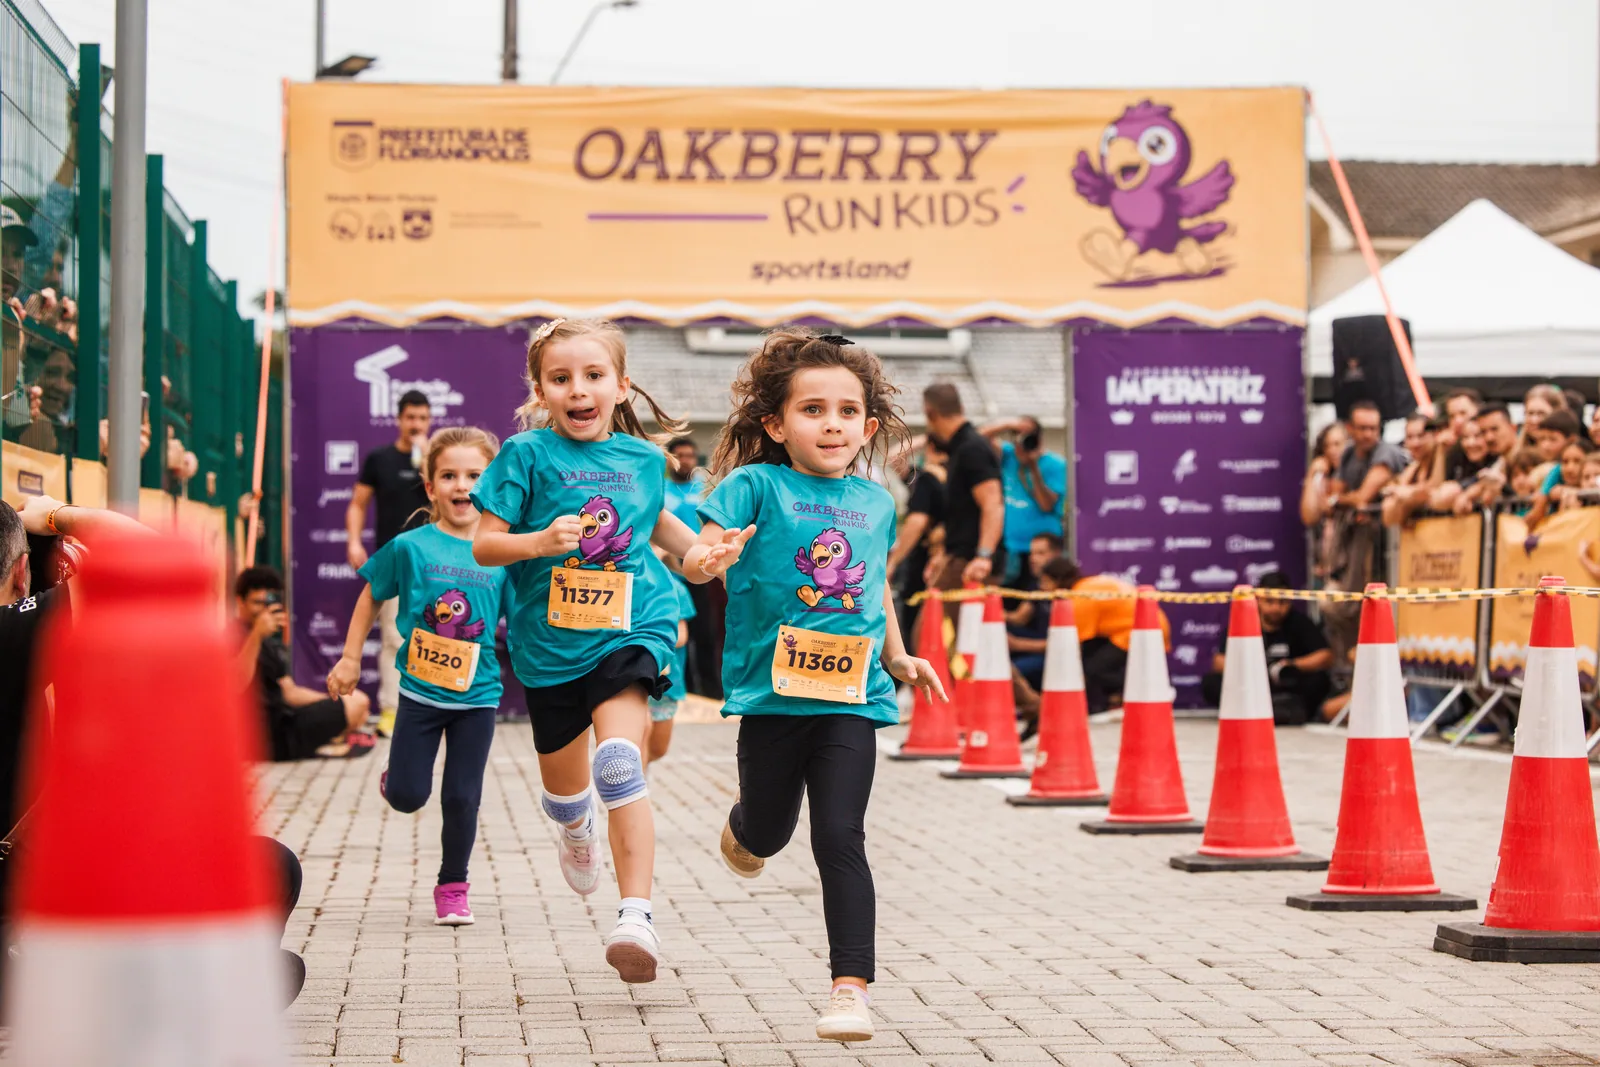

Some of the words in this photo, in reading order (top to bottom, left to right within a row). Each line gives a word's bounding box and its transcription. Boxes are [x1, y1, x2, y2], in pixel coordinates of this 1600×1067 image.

[379, 128, 498, 142] PREFEITURA
[504, 128, 529, 142] DE
[573, 127, 998, 183] OAKBERRY
[750, 257, 911, 281] sportsland
[1106, 375, 1266, 405] IMPERATRIZ
[559, 470, 633, 484] OAKBERRY
[792, 501, 868, 522] OAKBERRY
[424, 563, 493, 583] OAKBERRY
[560, 587, 614, 606] 11377
[416, 645, 462, 669] 11220
[787, 649, 853, 674] 11360
